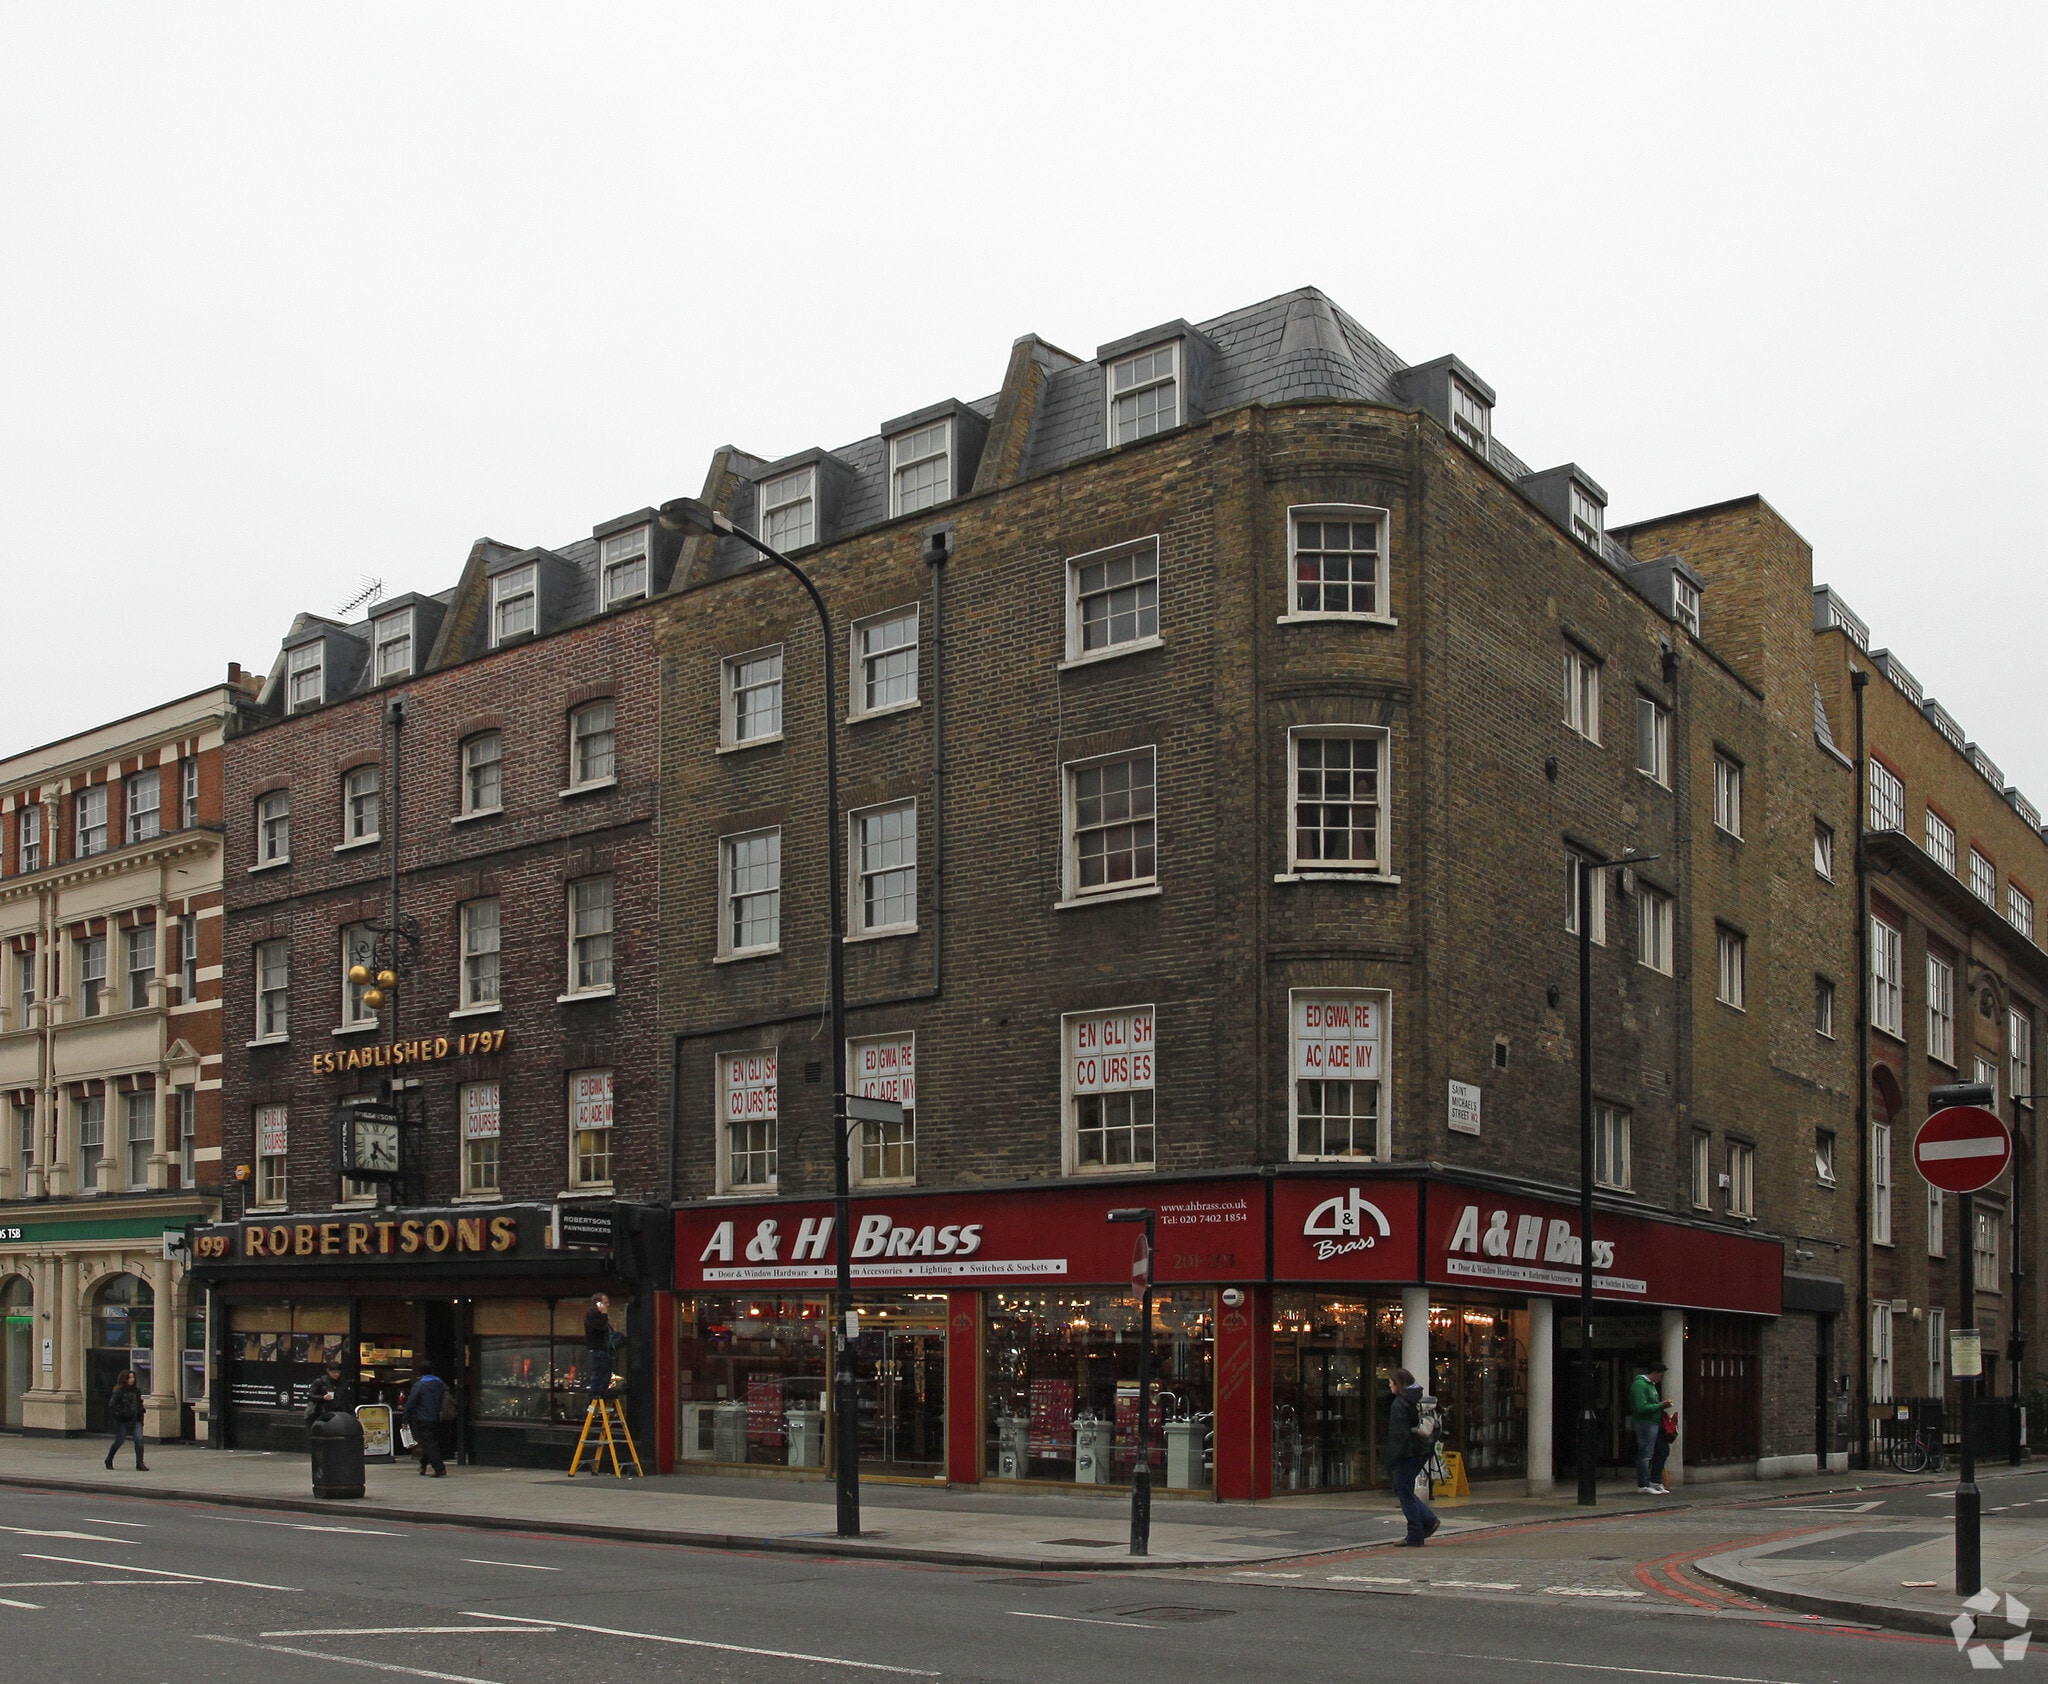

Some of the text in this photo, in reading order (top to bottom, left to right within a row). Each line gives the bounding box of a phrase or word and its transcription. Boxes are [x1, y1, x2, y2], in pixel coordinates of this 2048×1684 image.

[1306, 1005, 1369, 1028] EDGWARE
[1079, 1016, 1152, 1048] ENGLISH
[312, 1029, 505, 1075] ESTABLISHED 1797
[866, 1046, 912, 1071] EDGWARE
[1305, 1044, 1372, 1068] ACADEMY
[733, 1056, 776, 1083] ENGLISH
[1077, 1054, 1151, 1086] COURSES
[1452, 1084, 1467, 1097] SAINT
[1452, 1107, 1470, 1121] STREET
[1160, 1199, 1248, 1213] www.ahbrass.co.uk
[563, 1215, 611, 1226] ROBERTSONS
[563, 1225, 611, 1234] PAWNBROKERS
[1160, 1213, 1247, 1225] Tel: 020 7402 1854
[8, 1228, 21, 1239] TSB
[245, 1216, 516, 1256] ROBERTSONS
[699, 1221, 734, 1262] A
[745, 1219, 782, 1262] &
[790, 1216, 836, 1261] H
[1313, 1236, 1375, 1260] Brass
[718, 1270, 735, 1279] Door
[736, 1270, 742, 1278] &
[744, 1269, 772, 1278] Window
[773, 1268, 809, 1278] Hardware
[861, 1266, 903, 1276] Accessories
[920, 1265, 953, 1275] Lighting
[970, 1263, 1005, 1273] Switches
[1006, 1263, 1014, 1272] &
[1017, 1262, 1048, 1272] Sockets
[1458, 1262, 1471, 1272] Door
[1477, 1264, 1496, 1275] Window
